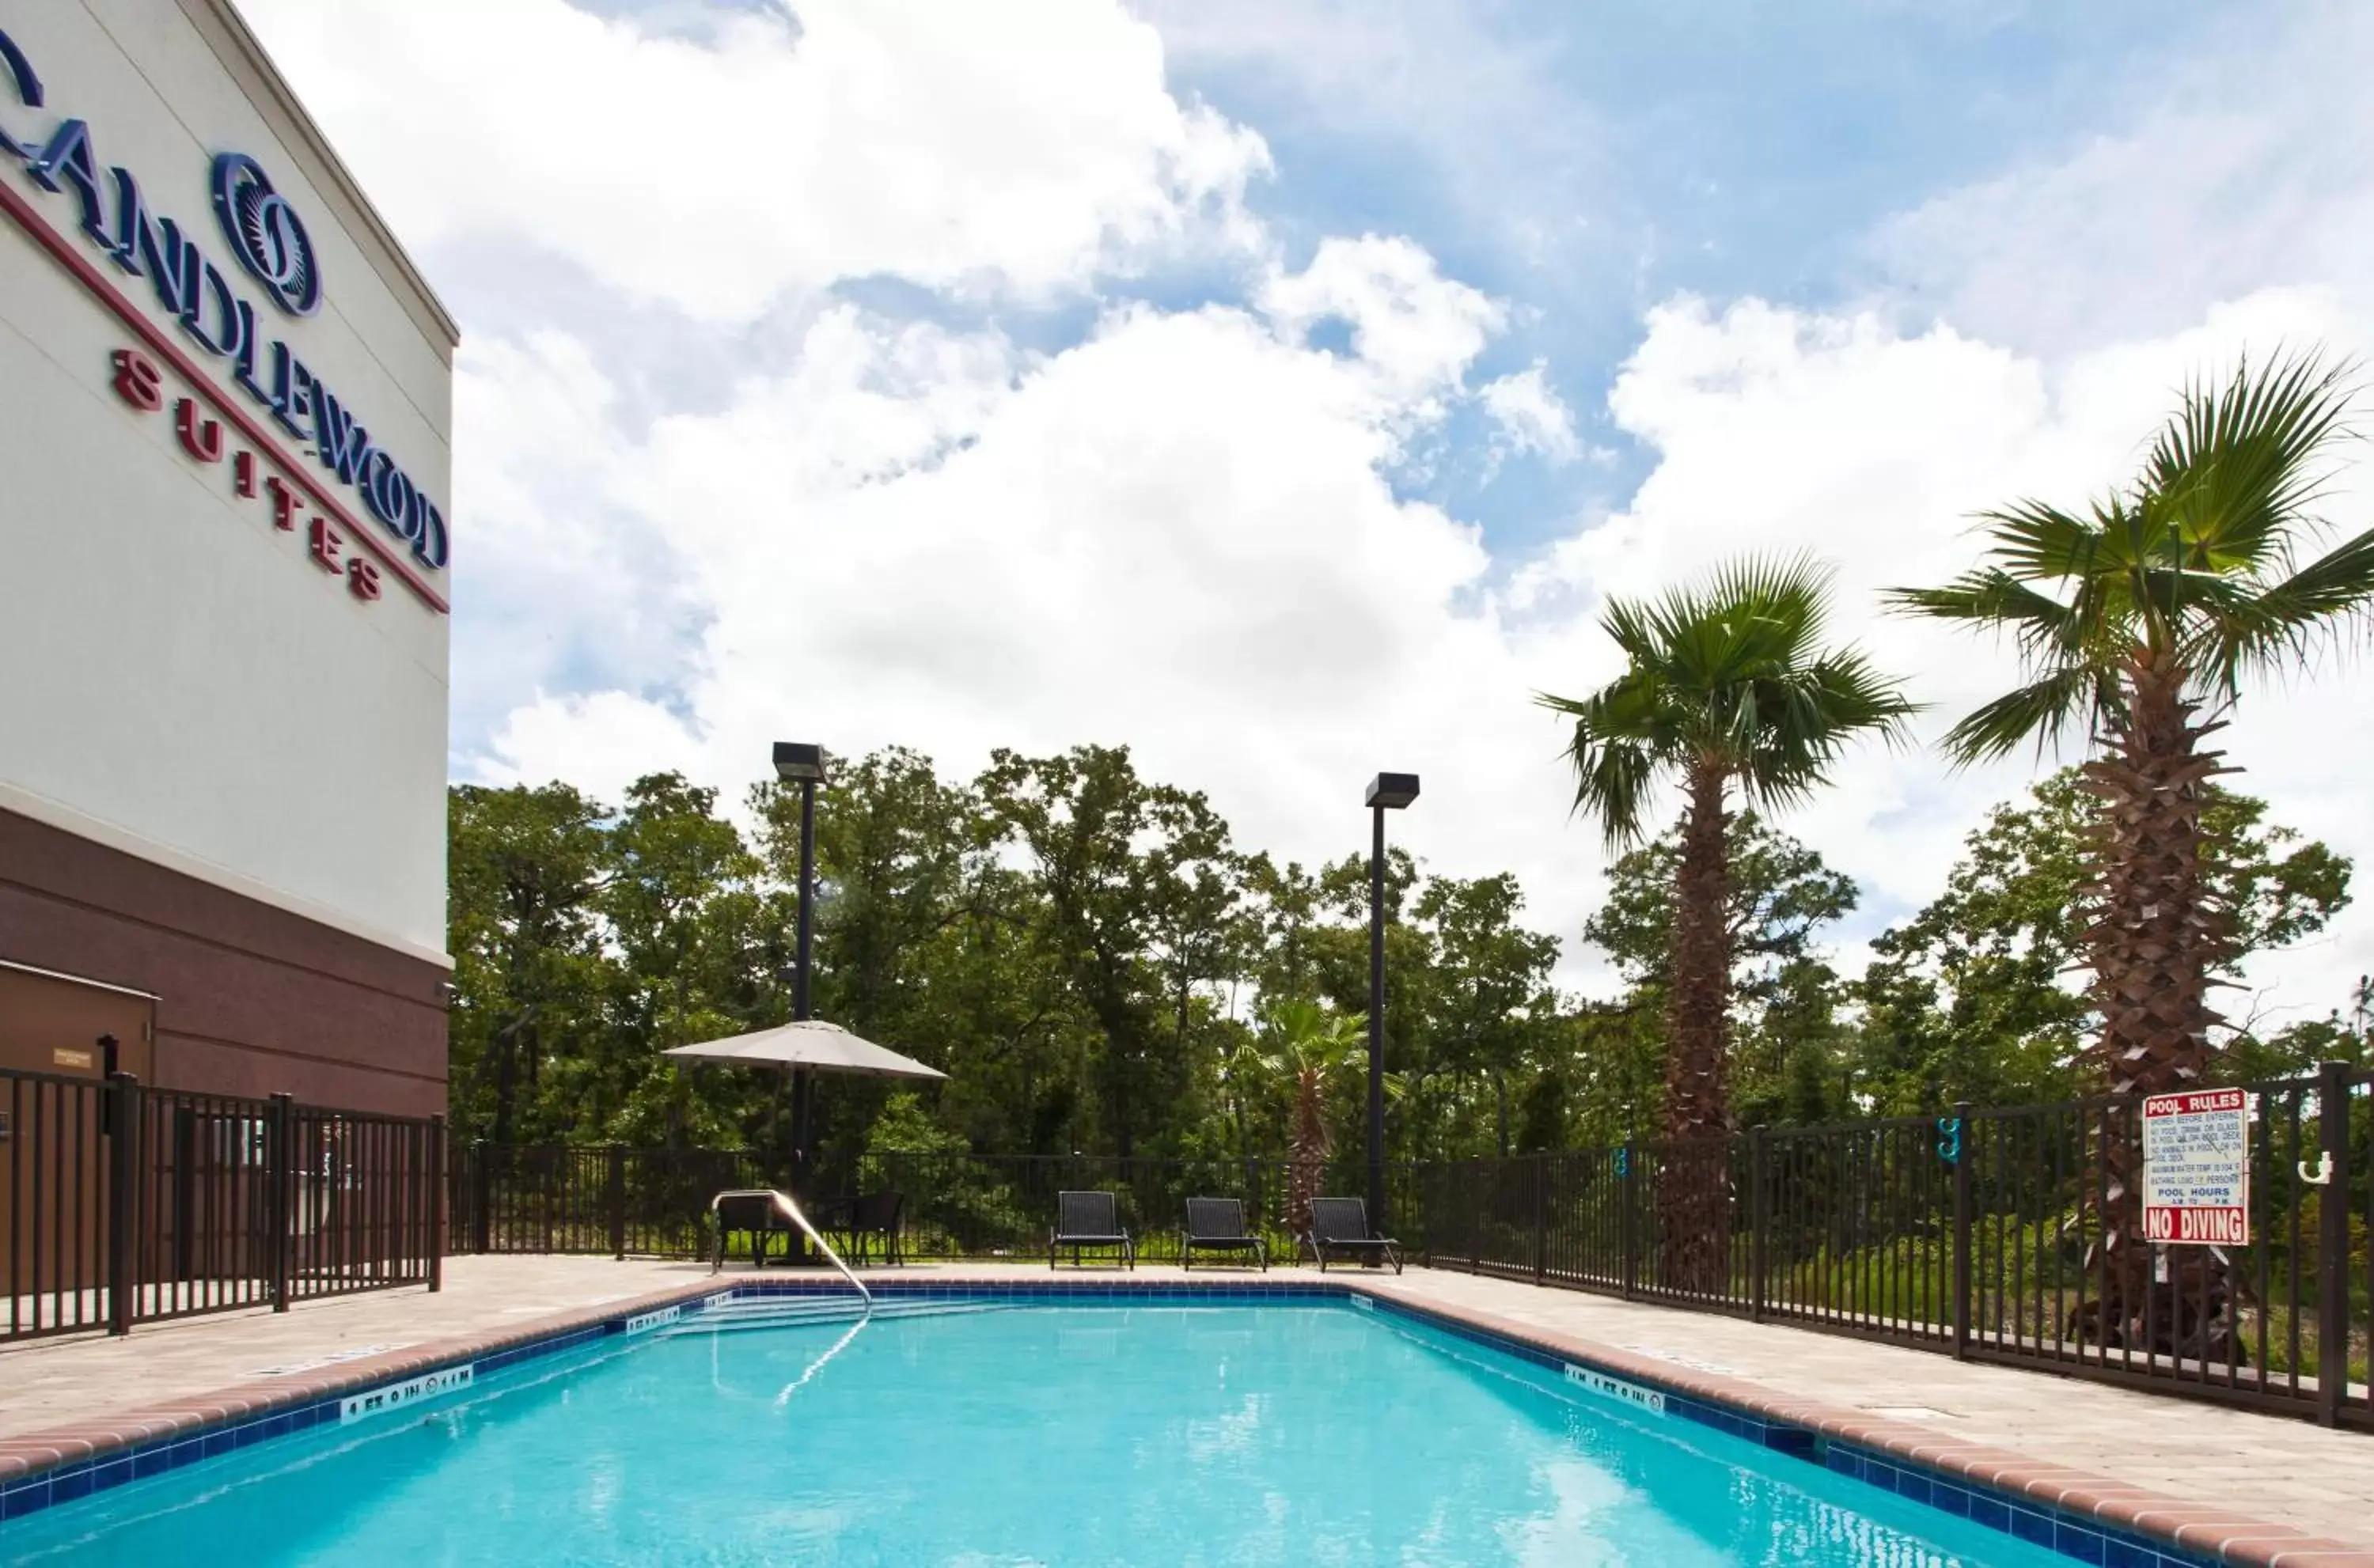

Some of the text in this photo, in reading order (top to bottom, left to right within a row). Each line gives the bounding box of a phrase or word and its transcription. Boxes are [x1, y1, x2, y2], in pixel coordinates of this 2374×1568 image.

[112, 348, 382, 600] SUITES
[2148, 1093, 2240, 1114] POOL RULES
[2177, 1115, 2202, 1123] BEFORE
[2158, 1187, 2230, 1196] POOL HOURS
[2148, 1208, 2242, 1240] NO DIVING
